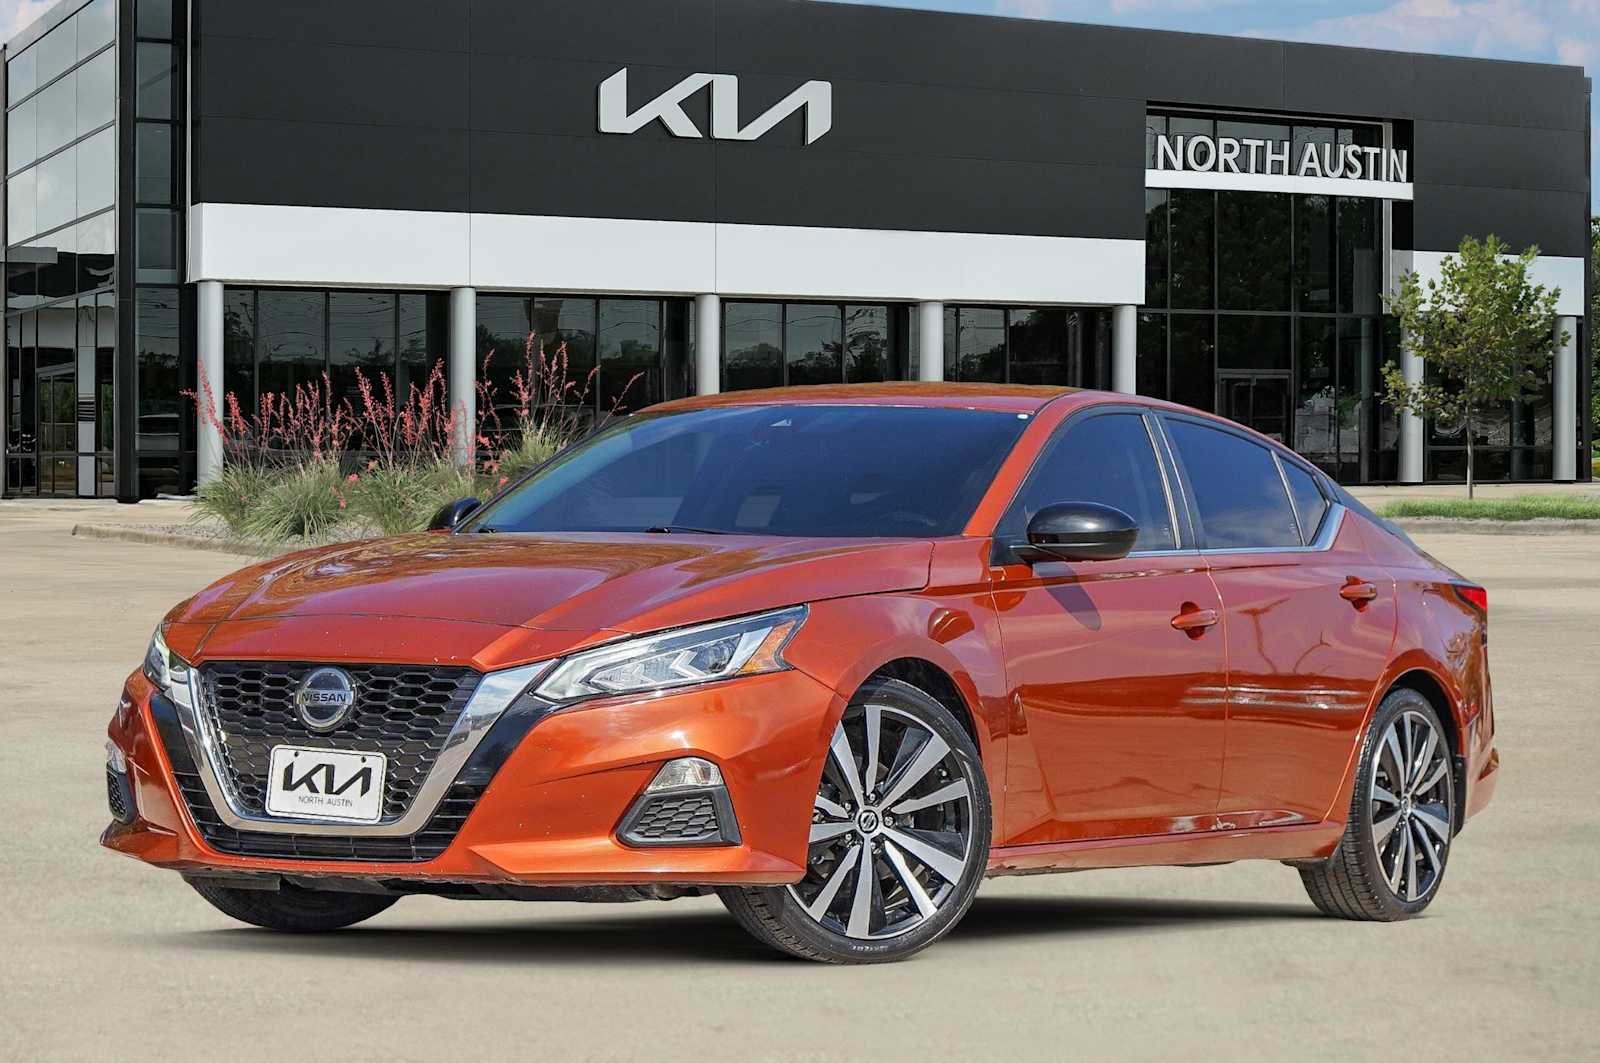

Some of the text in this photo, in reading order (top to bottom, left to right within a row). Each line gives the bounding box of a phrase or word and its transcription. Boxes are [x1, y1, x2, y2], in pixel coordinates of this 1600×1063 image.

[598, 67, 832, 145] KIA
[1156, 134, 1408, 183] NORTH AUSTIN
[302, 693, 346, 702] NISSAN
[298, 795, 353, 808] NORTH AUSTIN
